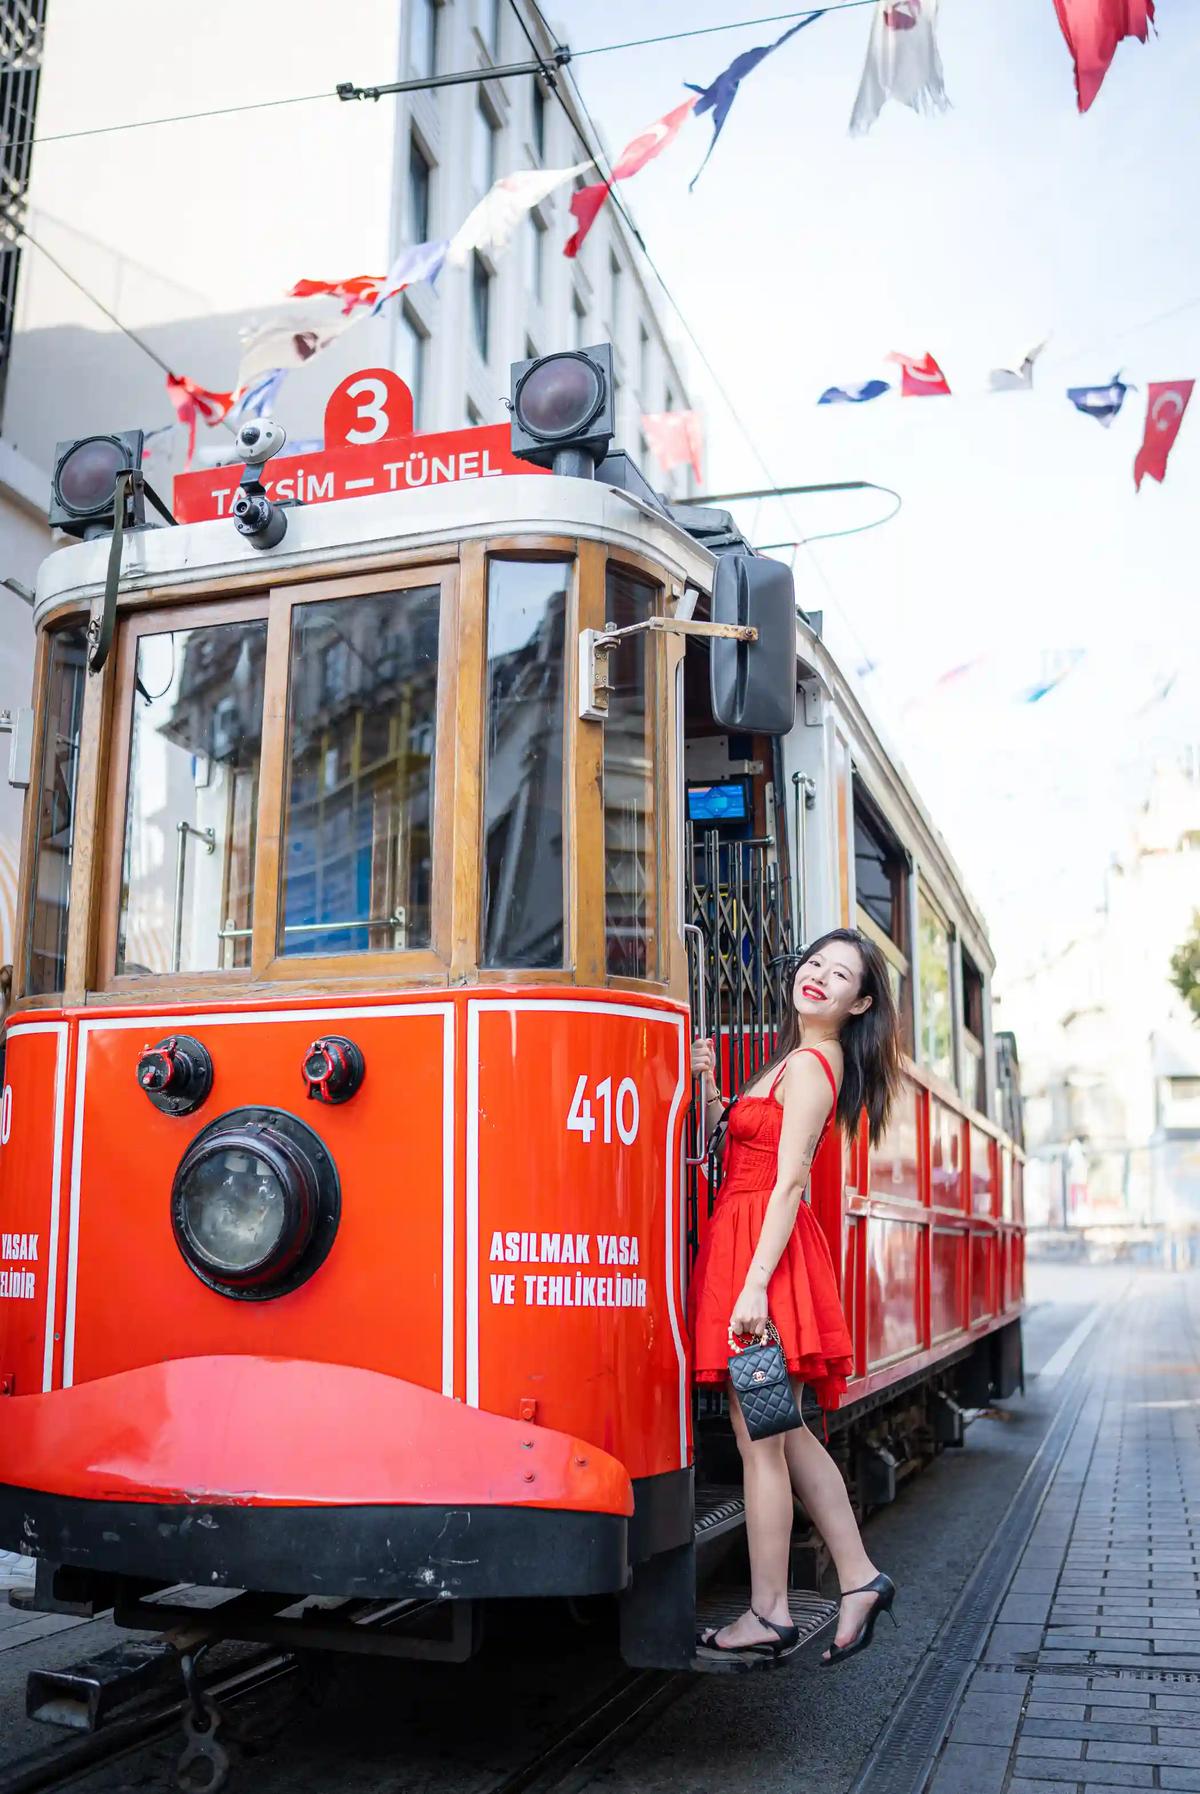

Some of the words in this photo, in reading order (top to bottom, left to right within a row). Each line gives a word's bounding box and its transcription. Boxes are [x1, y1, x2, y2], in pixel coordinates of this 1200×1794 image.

[346, 378, 389, 445] 3
[383, 451, 502, 489] TÜNEL
[566, 1074, 640, 1146] 410
[2, 1233, 39, 1260] YASAK
[489, 1231, 590, 1263] ASILMAK
[597, 1235, 639, 1265] YASA
[0, 1267, 35, 1299] ELİDİR
[490, 1274, 515, 1305] VE
[524, 1271, 647, 1307] TEHLİKELİDİR
